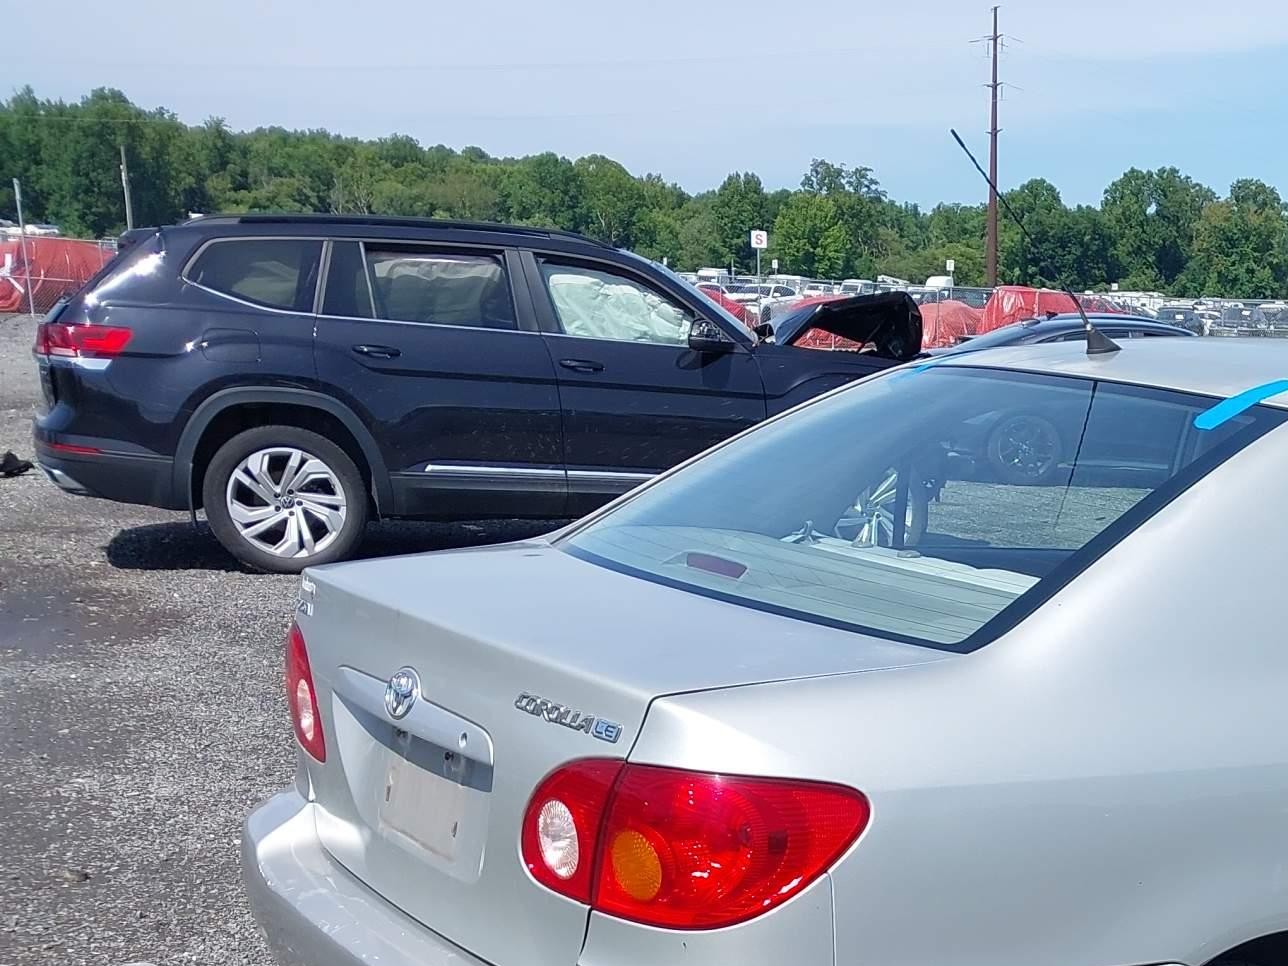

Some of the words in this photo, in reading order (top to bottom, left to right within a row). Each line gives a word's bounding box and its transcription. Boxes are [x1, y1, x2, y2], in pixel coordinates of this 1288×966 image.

[755, 233, 763, 245] S
[514, 693, 595, 735] COROLLA
[593, 719, 621, 742] LE
